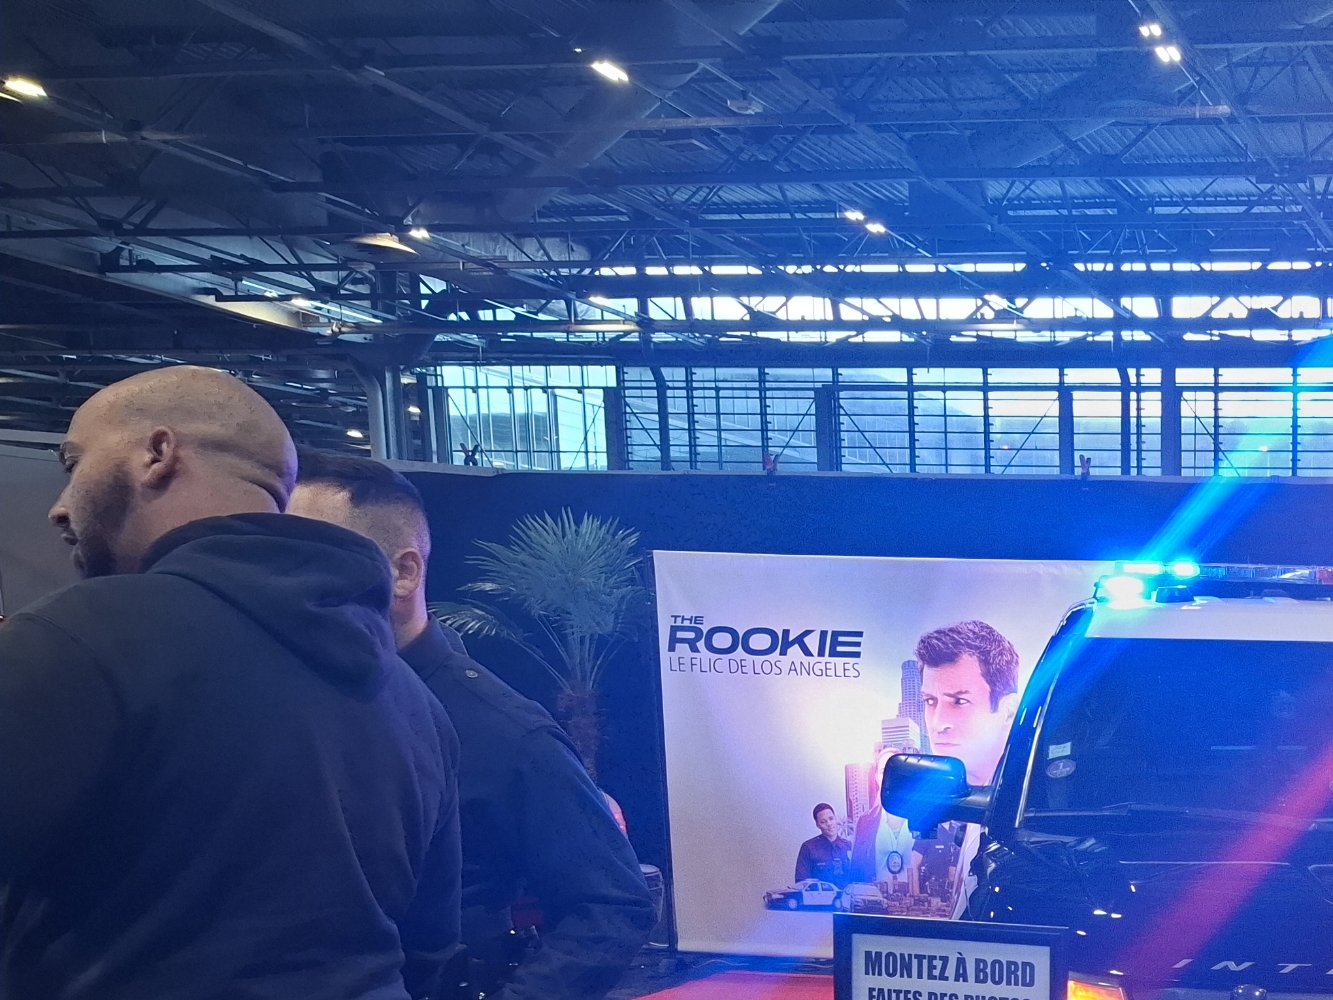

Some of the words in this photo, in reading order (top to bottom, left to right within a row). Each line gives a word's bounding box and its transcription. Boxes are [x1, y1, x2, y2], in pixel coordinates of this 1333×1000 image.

[671, 615, 704, 625] THE
[667, 625, 864, 659] ROOKIE
[669, 657, 686, 672] LE
[690, 657, 724, 674] FLIC
[728, 658, 749, 675] DE
[752, 659, 783, 676] LOS
[787, 661, 861, 678] ANGELES
[864, 950, 949, 982] MONTEZ
[953, 951, 969, 983] À
[974, 957, 1036, 988] BORD
